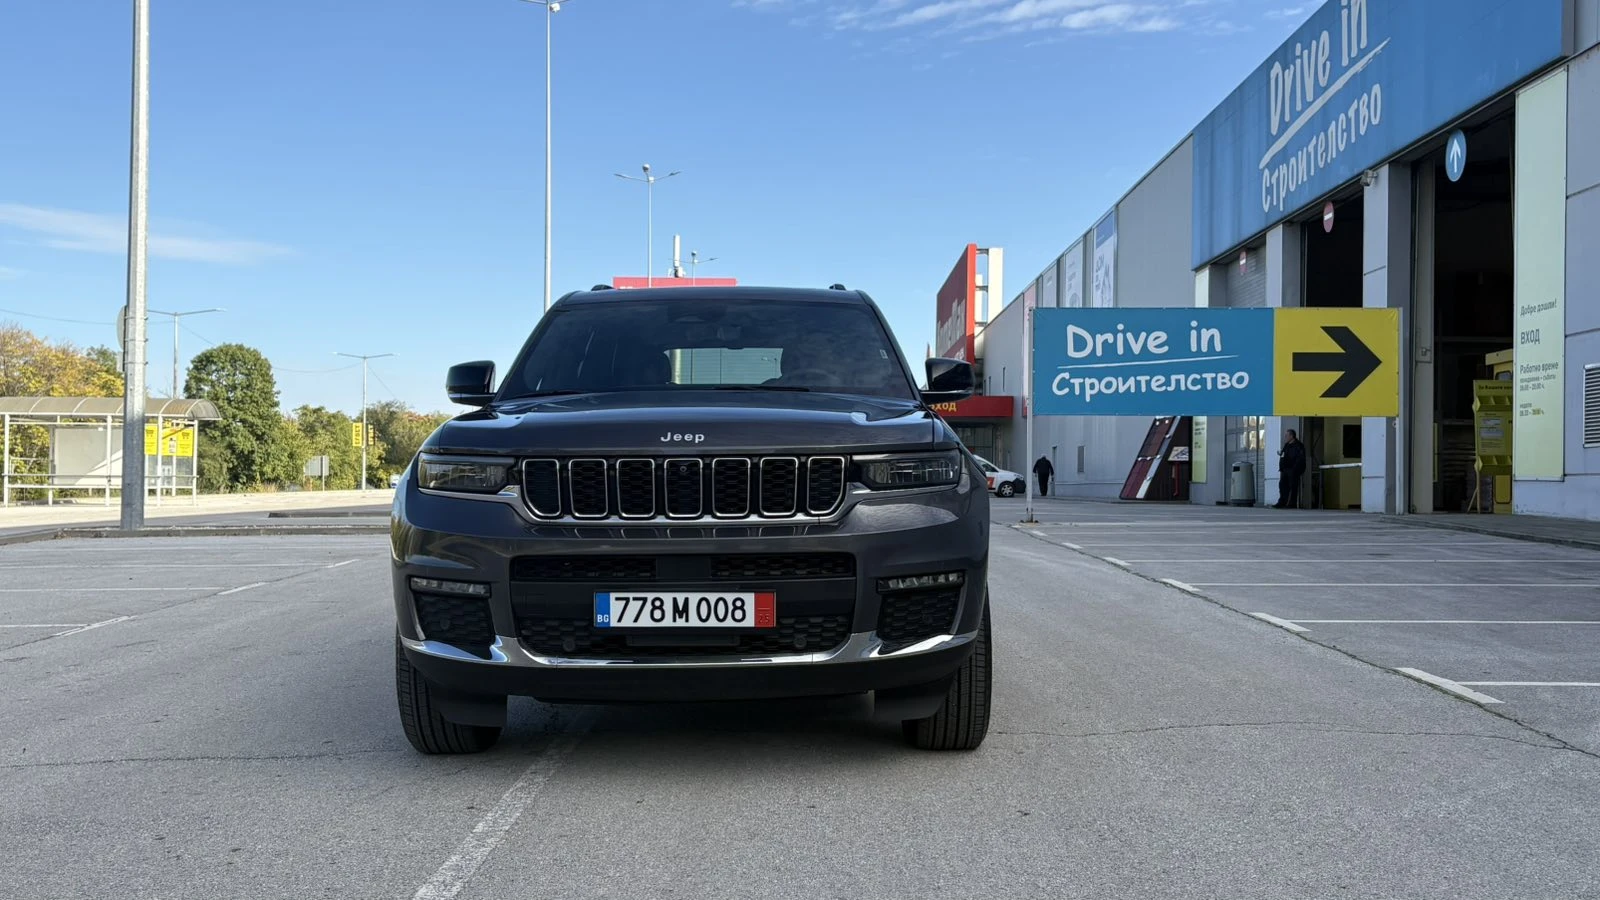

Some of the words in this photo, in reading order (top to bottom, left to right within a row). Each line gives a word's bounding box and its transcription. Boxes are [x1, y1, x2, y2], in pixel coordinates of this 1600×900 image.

[1270, 30, 1331, 136] Drive
[1341, 0, 1368, 67] in
[1262, 83, 1382, 213] Строителство
[1066, 323, 1169, 358] Drive
[1190, 320, 1222, 352] in
[1520, 328, 1541, 344] ВХОД
[1052, 371, 1250, 402] Строителство
[660, 431, 705, 444] Jeep
[597, 614, 609, 623] BG
[614, 597, 666, 623] 778
[672, 597, 690, 623] M
[696, 597, 747, 623] 008
